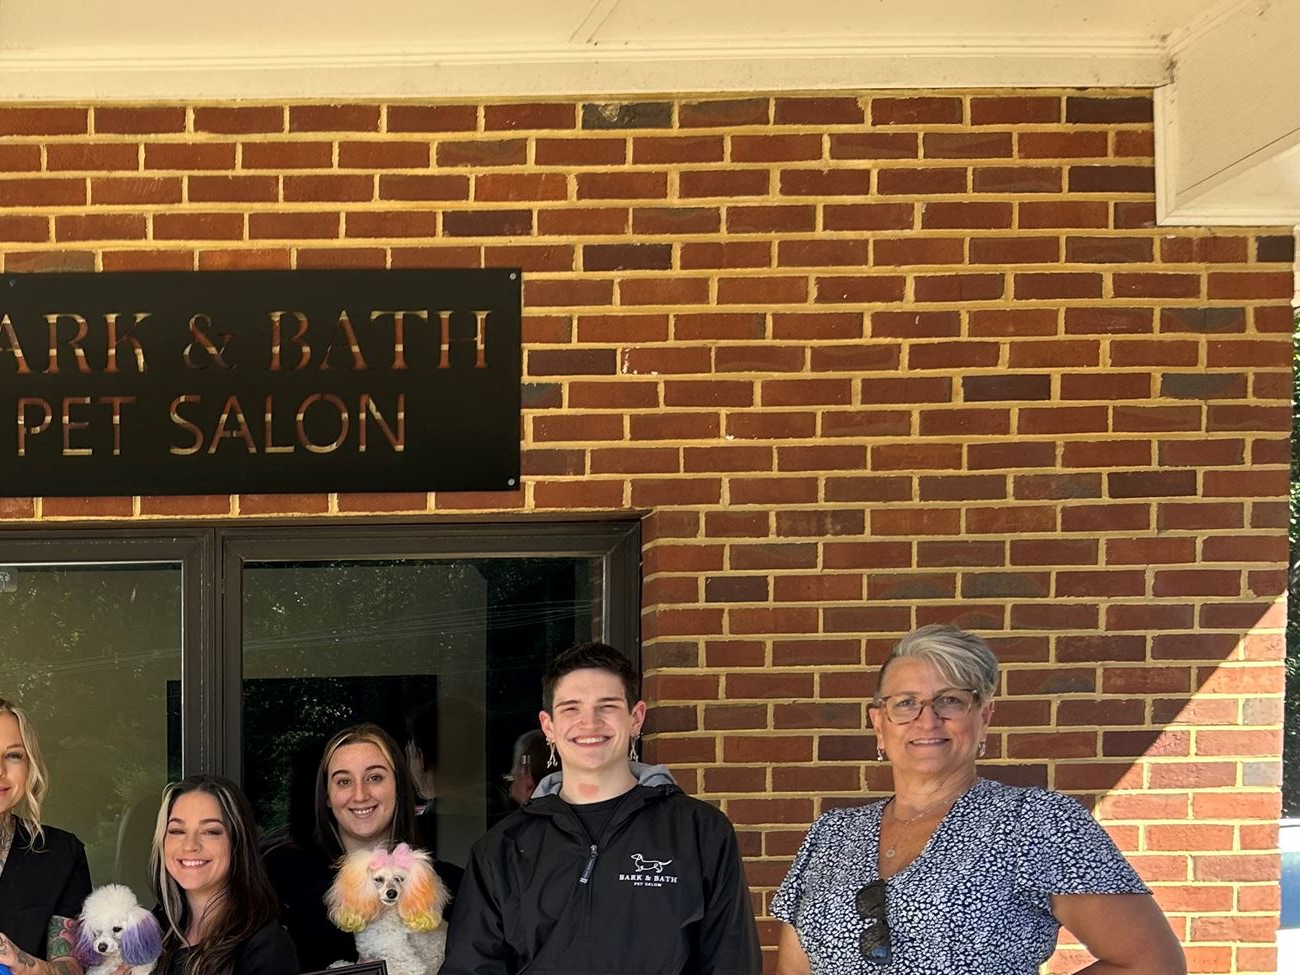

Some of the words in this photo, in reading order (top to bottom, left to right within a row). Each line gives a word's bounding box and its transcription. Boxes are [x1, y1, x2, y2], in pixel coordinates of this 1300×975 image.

[181, 312, 238, 370] &
[270, 309, 495, 371] BATH
[17, 395, 137, 456] PET
[168, 393, 406, 456] SALON
[654, 875, 678, 883] BATH
